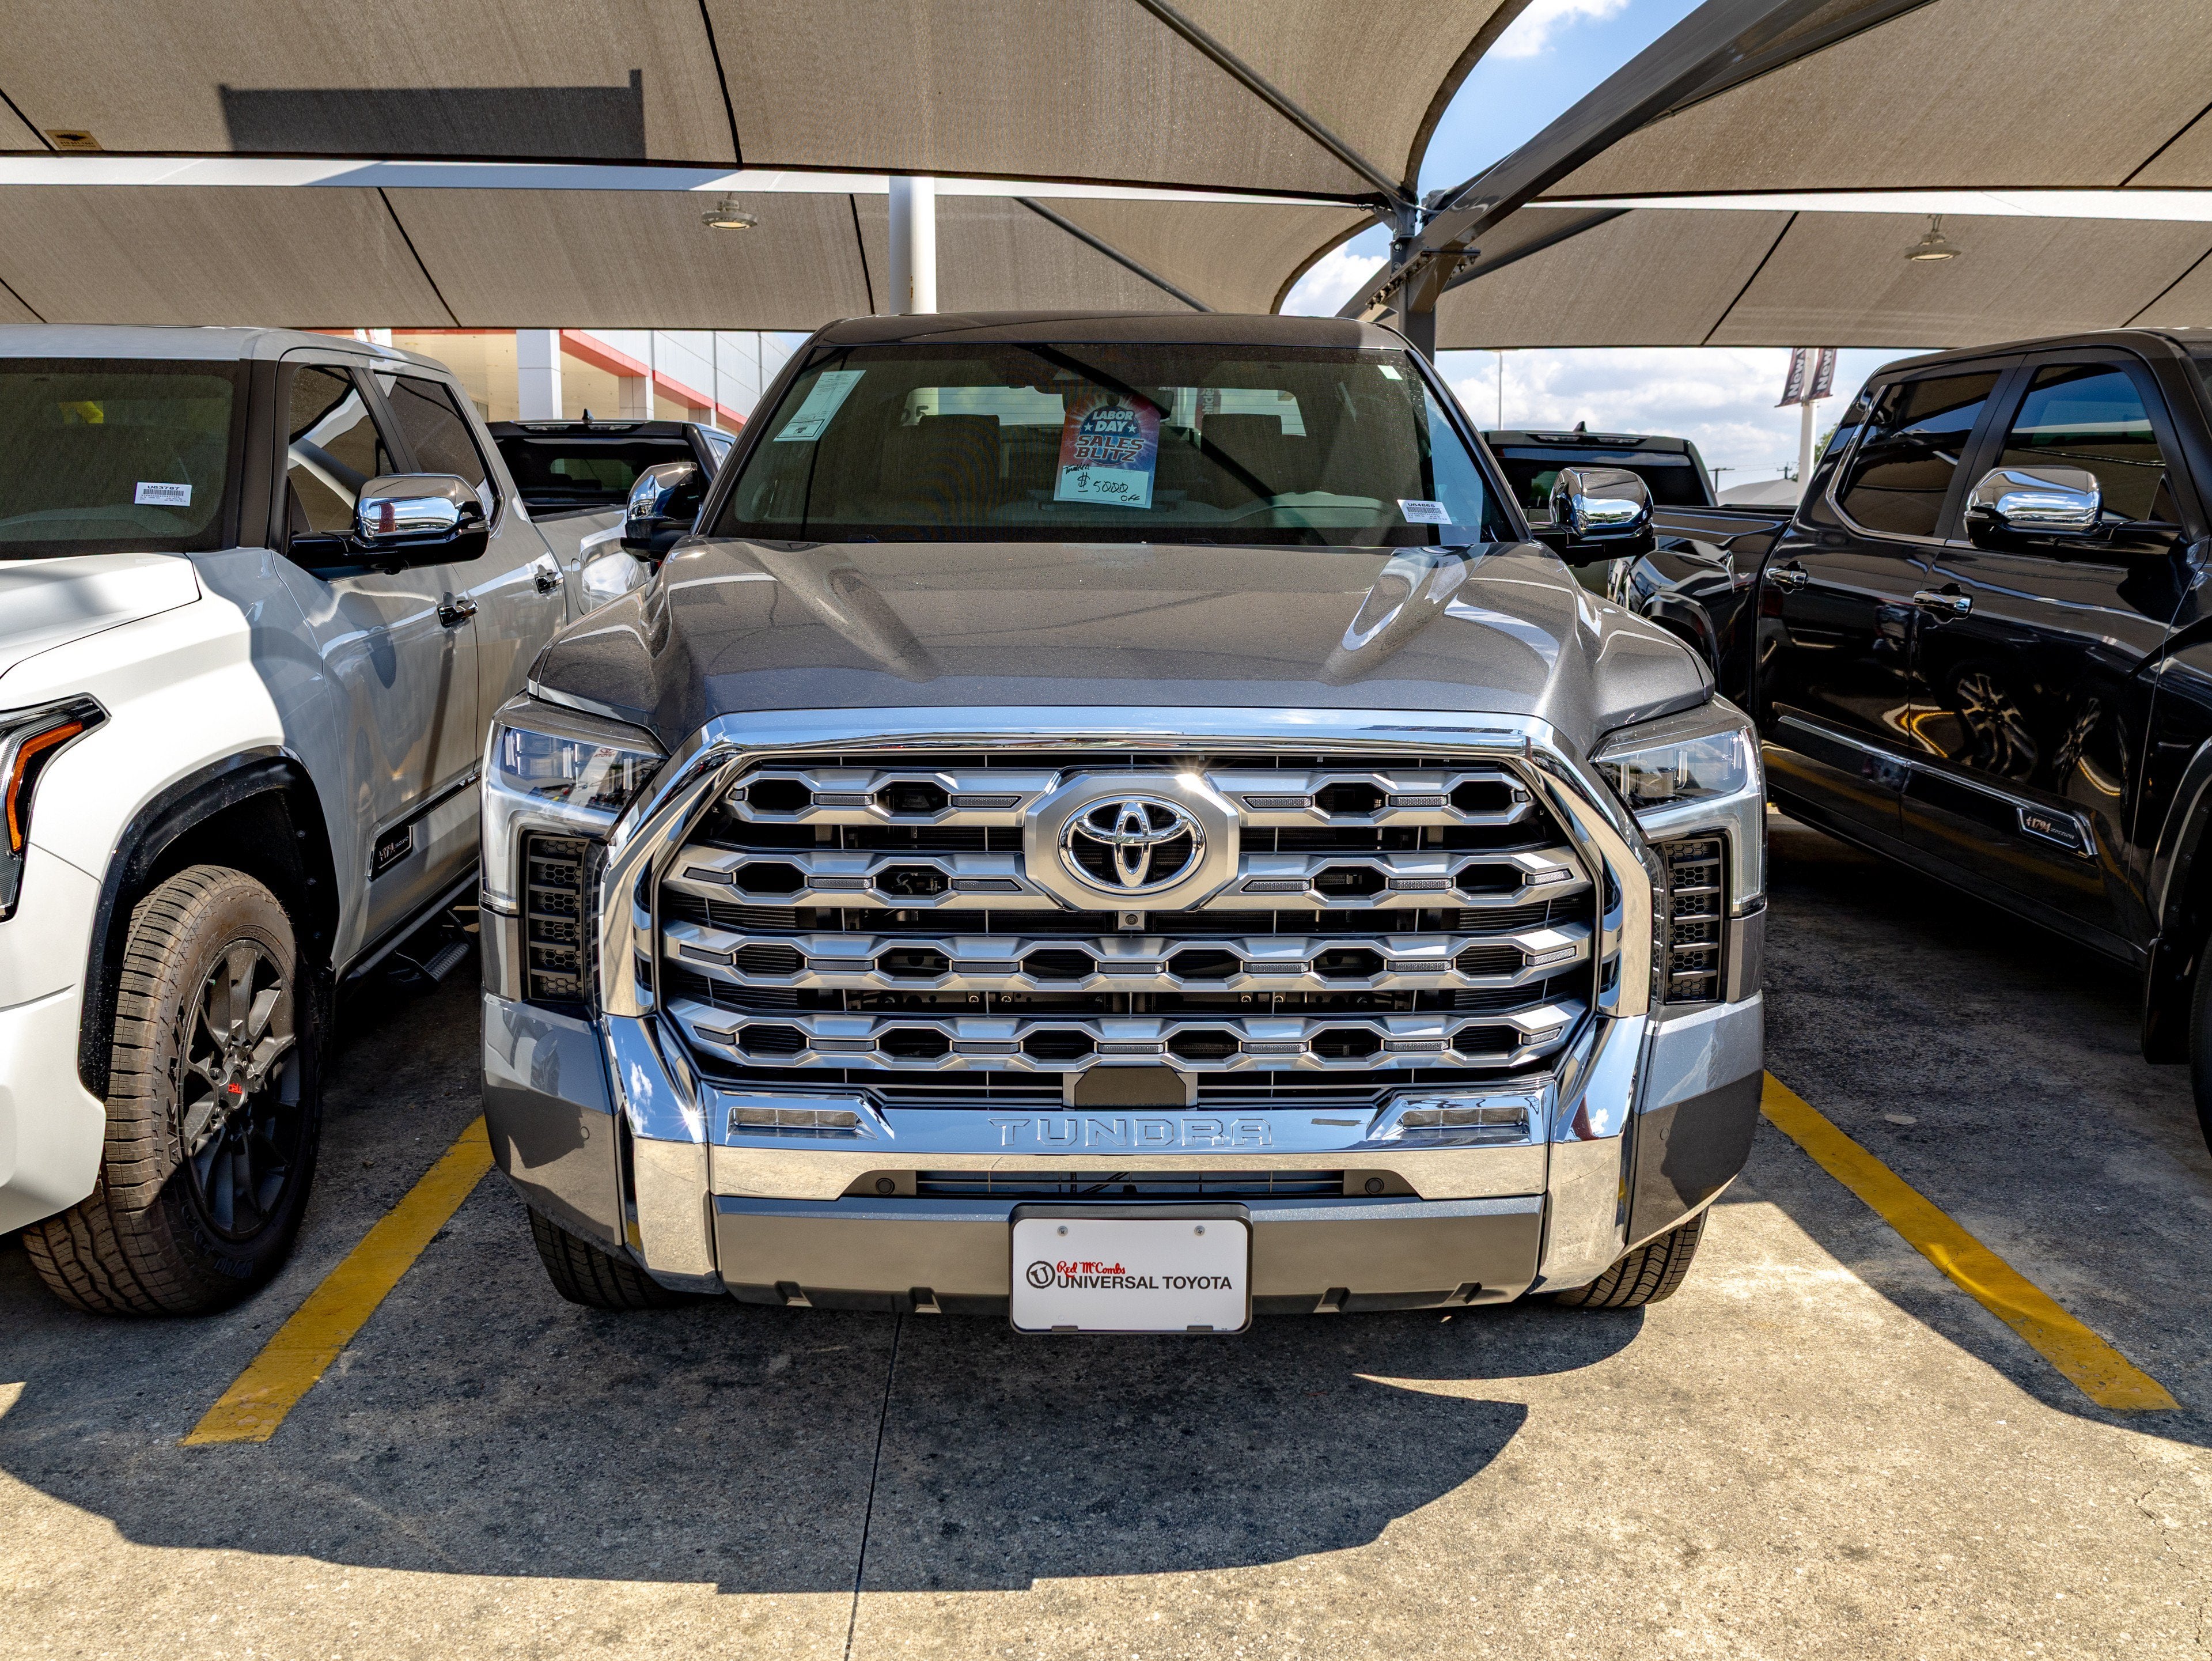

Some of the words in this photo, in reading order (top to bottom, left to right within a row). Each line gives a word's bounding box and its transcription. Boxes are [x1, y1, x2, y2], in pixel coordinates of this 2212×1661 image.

[1787, 358, 1805, 398] New
[1816, 350, 1832, 391] New
[1093, 411, 1134, 421] LABOR
[1095, 422, 1127, 432] DAY
[1076, 435, 1145, 451] SALES
[1075, 447, 1138, 462] BLITZ
[987, 1118, 1273, 1147] TUNDRA
[1056, 1261, 1077, 1278] Red
[1079, 1261, 1126, 1275] McCombs
[1057, 1276, 1159, 1289] UNIVERSAL
[1162, 1276, 1232, 1290] TOYOTA
